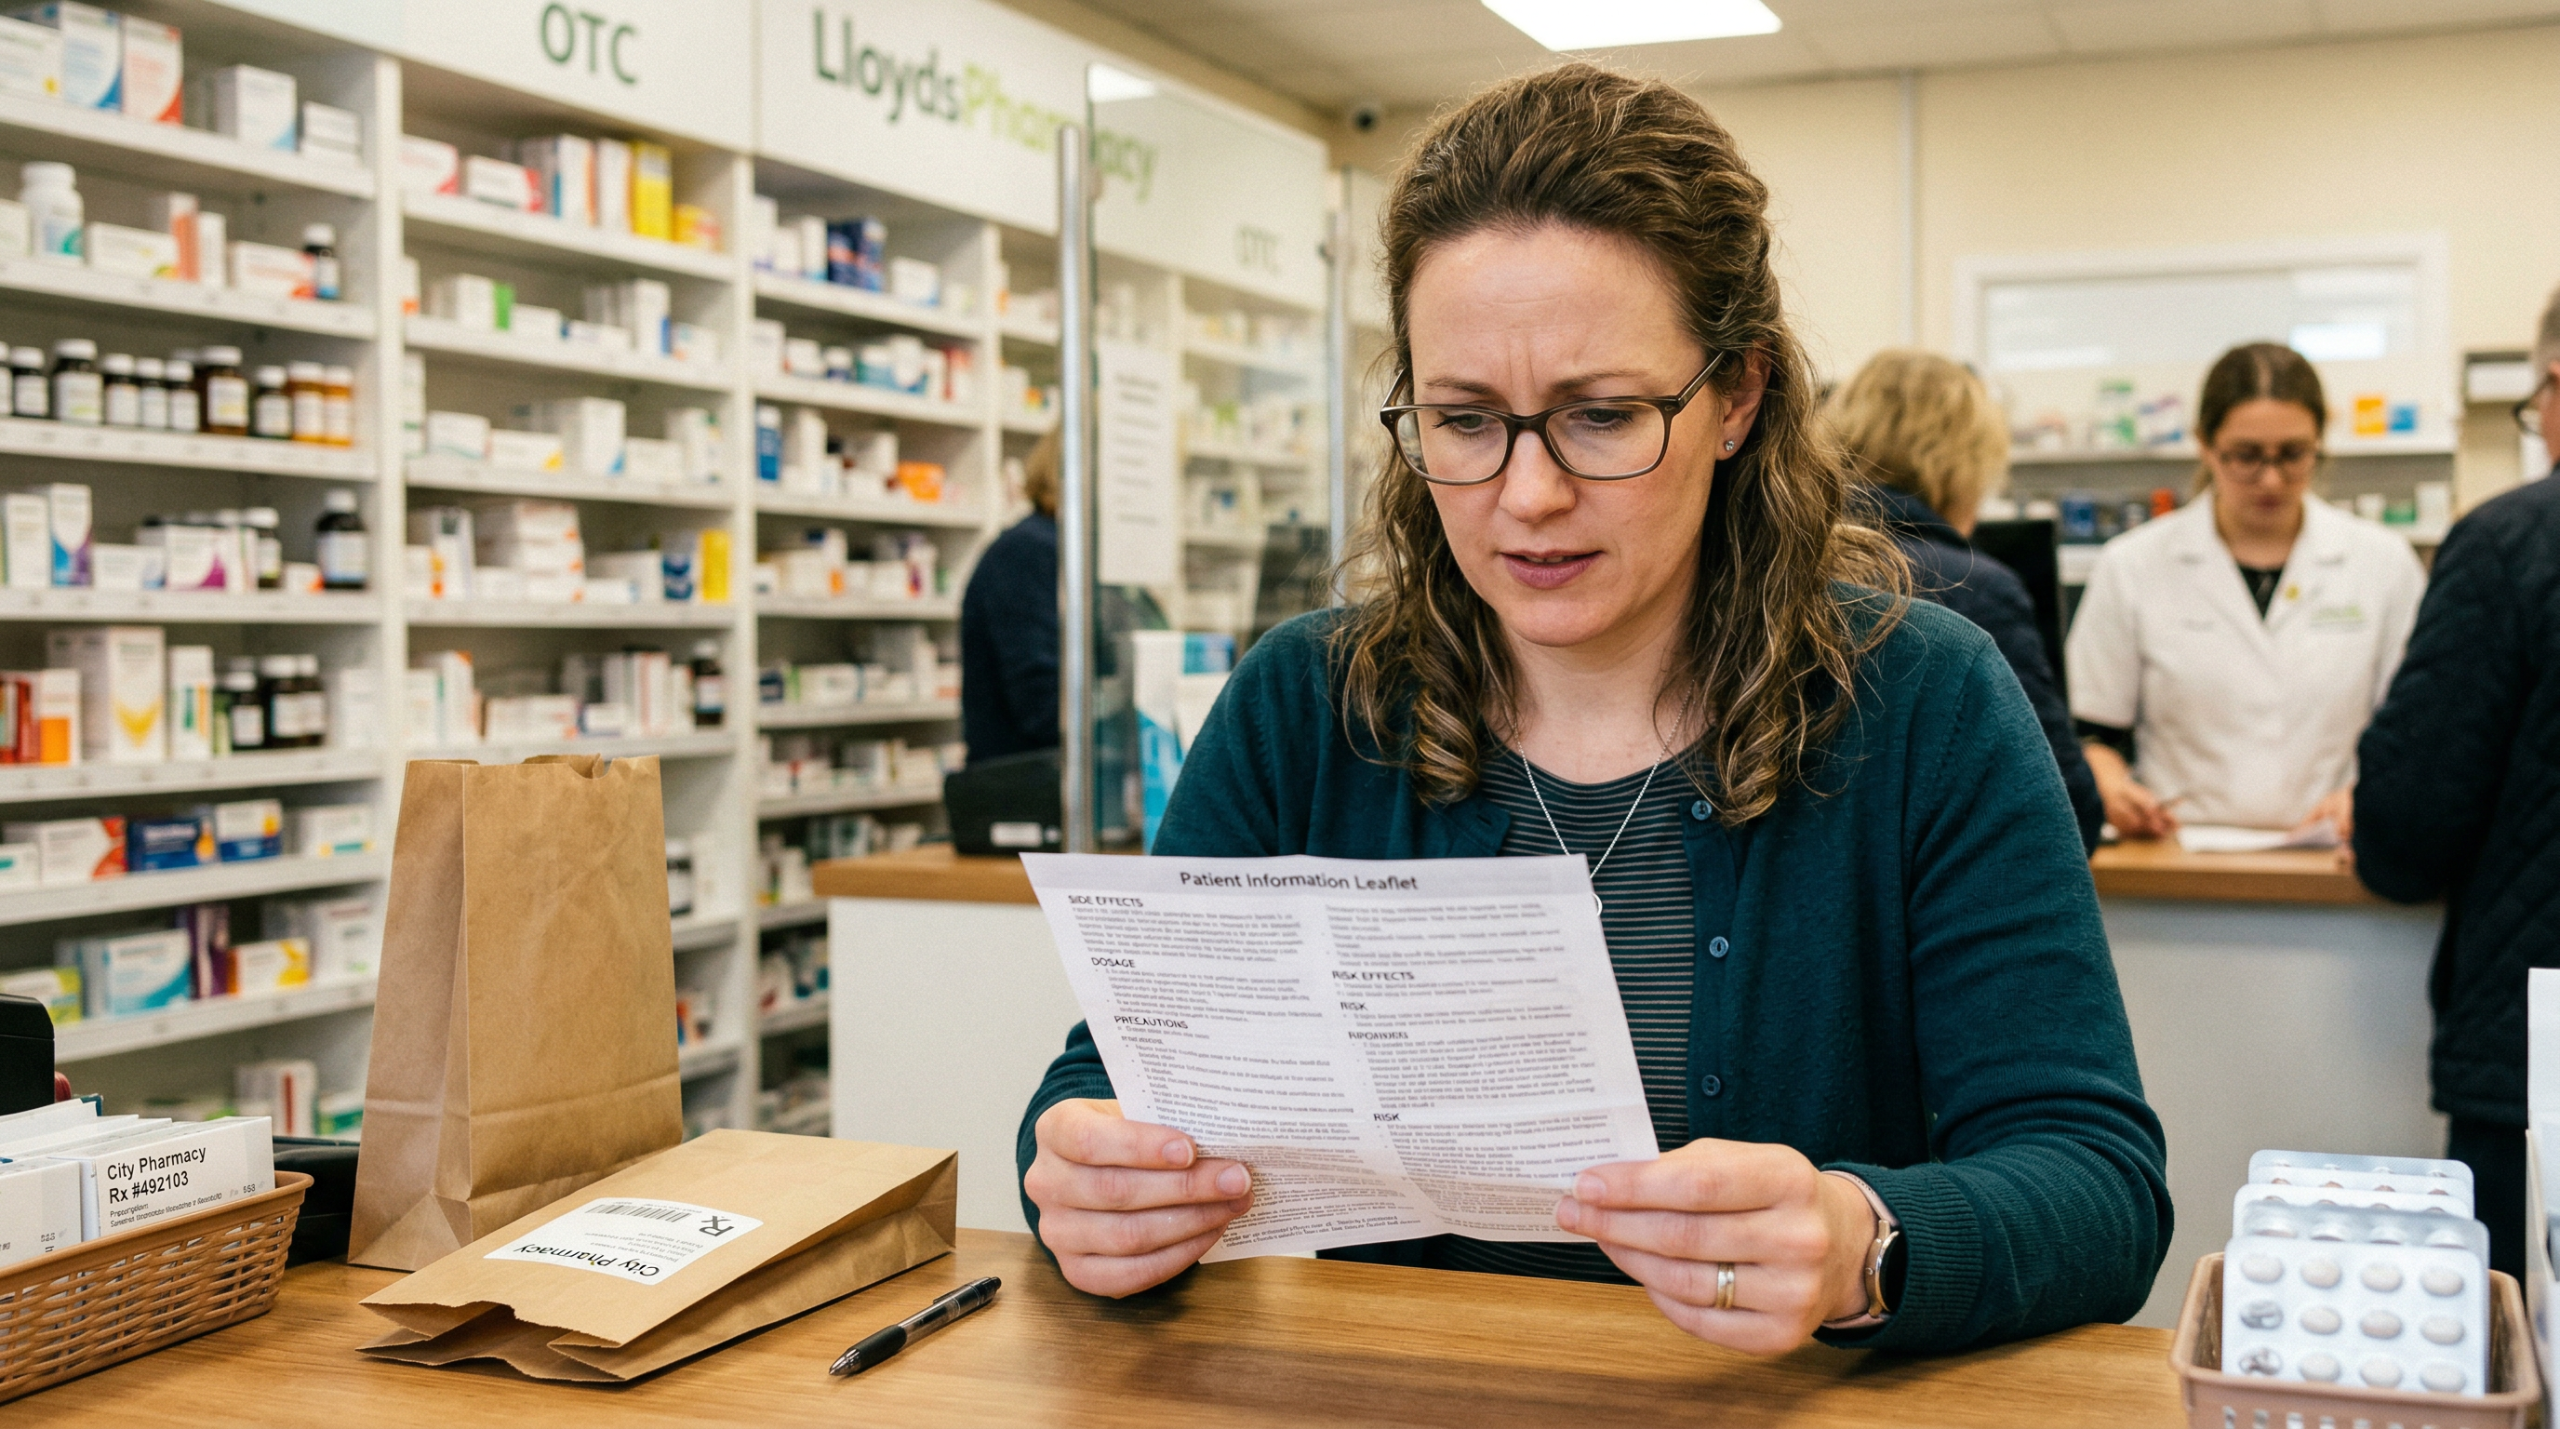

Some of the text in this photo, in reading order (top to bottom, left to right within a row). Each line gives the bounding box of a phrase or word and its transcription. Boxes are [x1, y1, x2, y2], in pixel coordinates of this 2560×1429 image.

[540, 3, 637, 85] OTC
[813, 8, 1158, 203] LloydsPharacy
[1180, 871, 1419, 891] Patient Information Leaflet
[1091, 957, 1136, 968] DOSAGE
[1373, 1112, 1401, 1122] RISK
[107, 1147, 206, 1181] City Pharmacy
[109, 1170, 189, 1204] Rx #492103
[514, 1243, 618, 1267] Pharmacy
[618, 1258, 660, 1277] City
